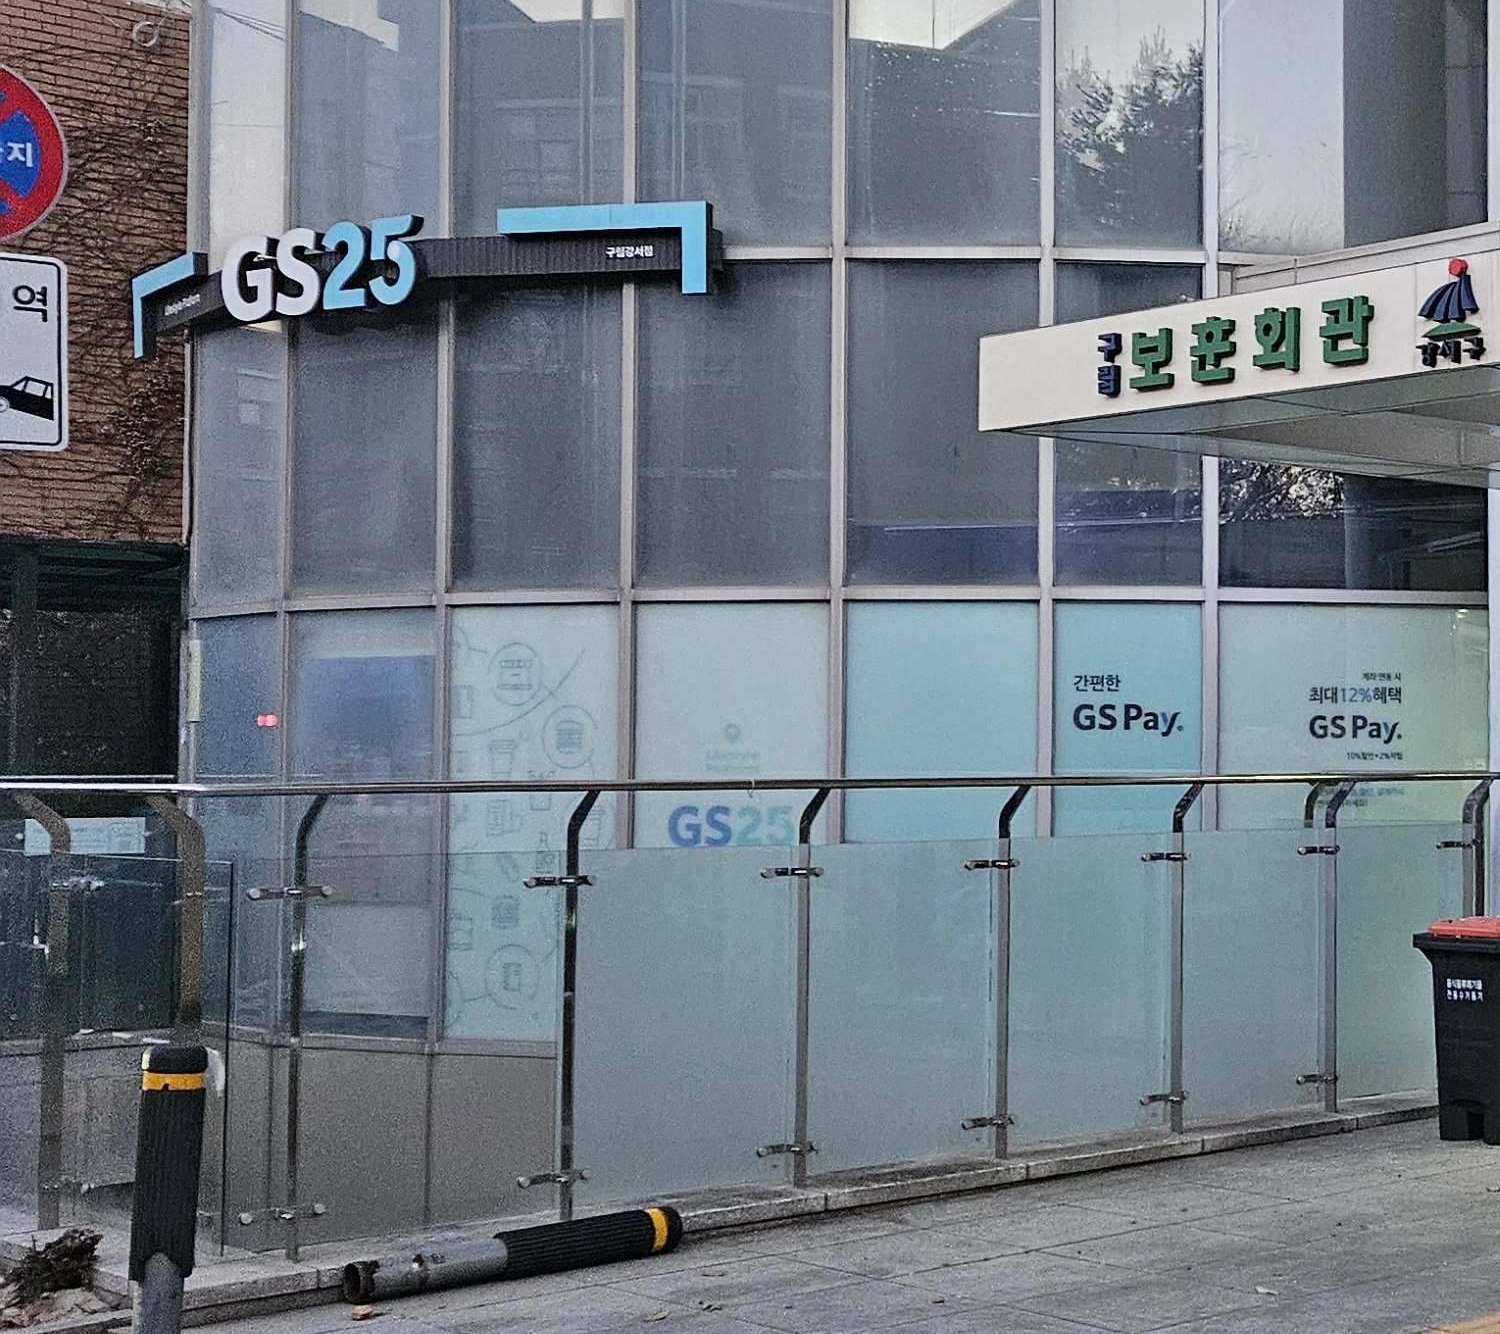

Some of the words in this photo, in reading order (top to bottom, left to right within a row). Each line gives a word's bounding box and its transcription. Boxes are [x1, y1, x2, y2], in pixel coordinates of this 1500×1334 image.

[605, 245, 654, 258] 구립강서점
[221, 214, 418, 322] GS25
[1129, 294, 1375, 392] 보훈회관
[1073, 674, 1122, 692] 간편한
[1073, 703, 1117, 731] GS
[1309, 715, 1347, 739] GS
[668, 805, 796, 848] GS25
